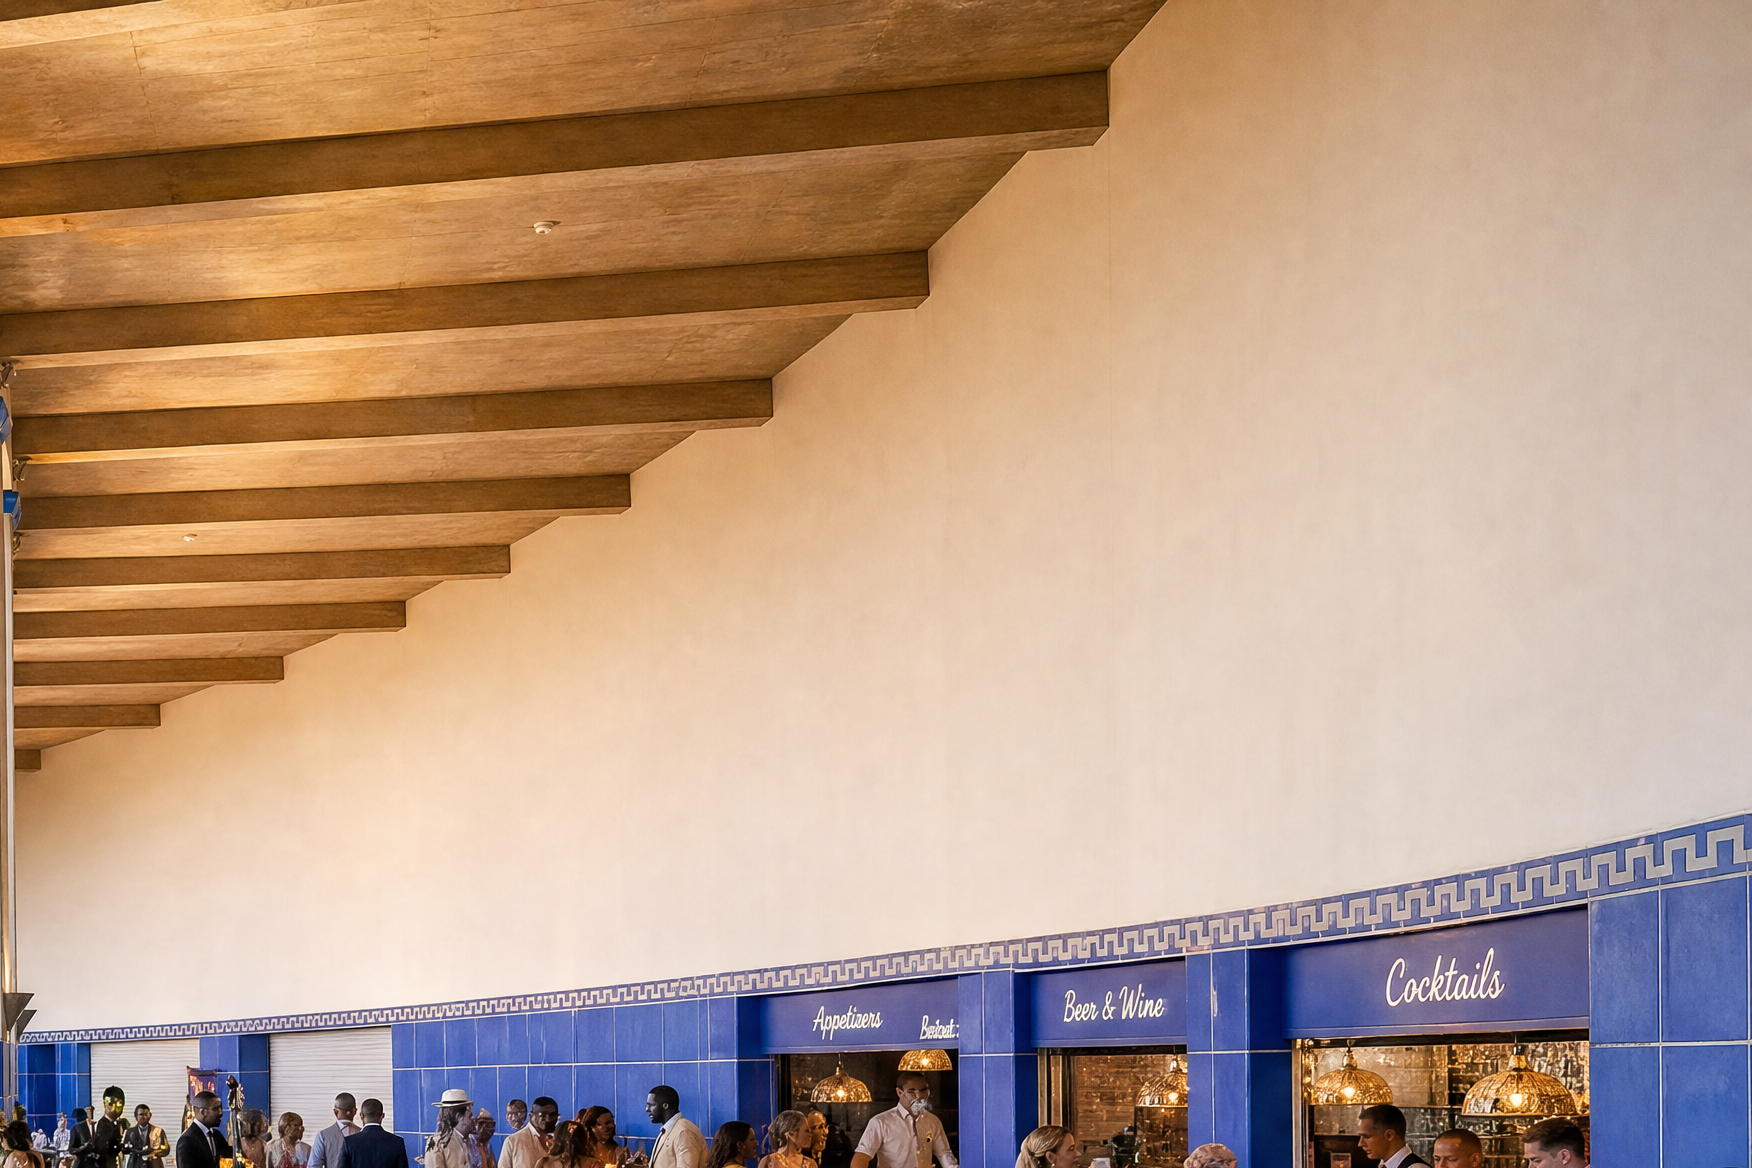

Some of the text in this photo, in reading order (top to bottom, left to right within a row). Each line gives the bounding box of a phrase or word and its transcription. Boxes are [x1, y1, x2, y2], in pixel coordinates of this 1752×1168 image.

[1386, 947, 1506, 1007] Cocktails
[1063, 983, 1167, 1022] Beer & Wine
[812, 1004, 883, 1041] Appetizers
